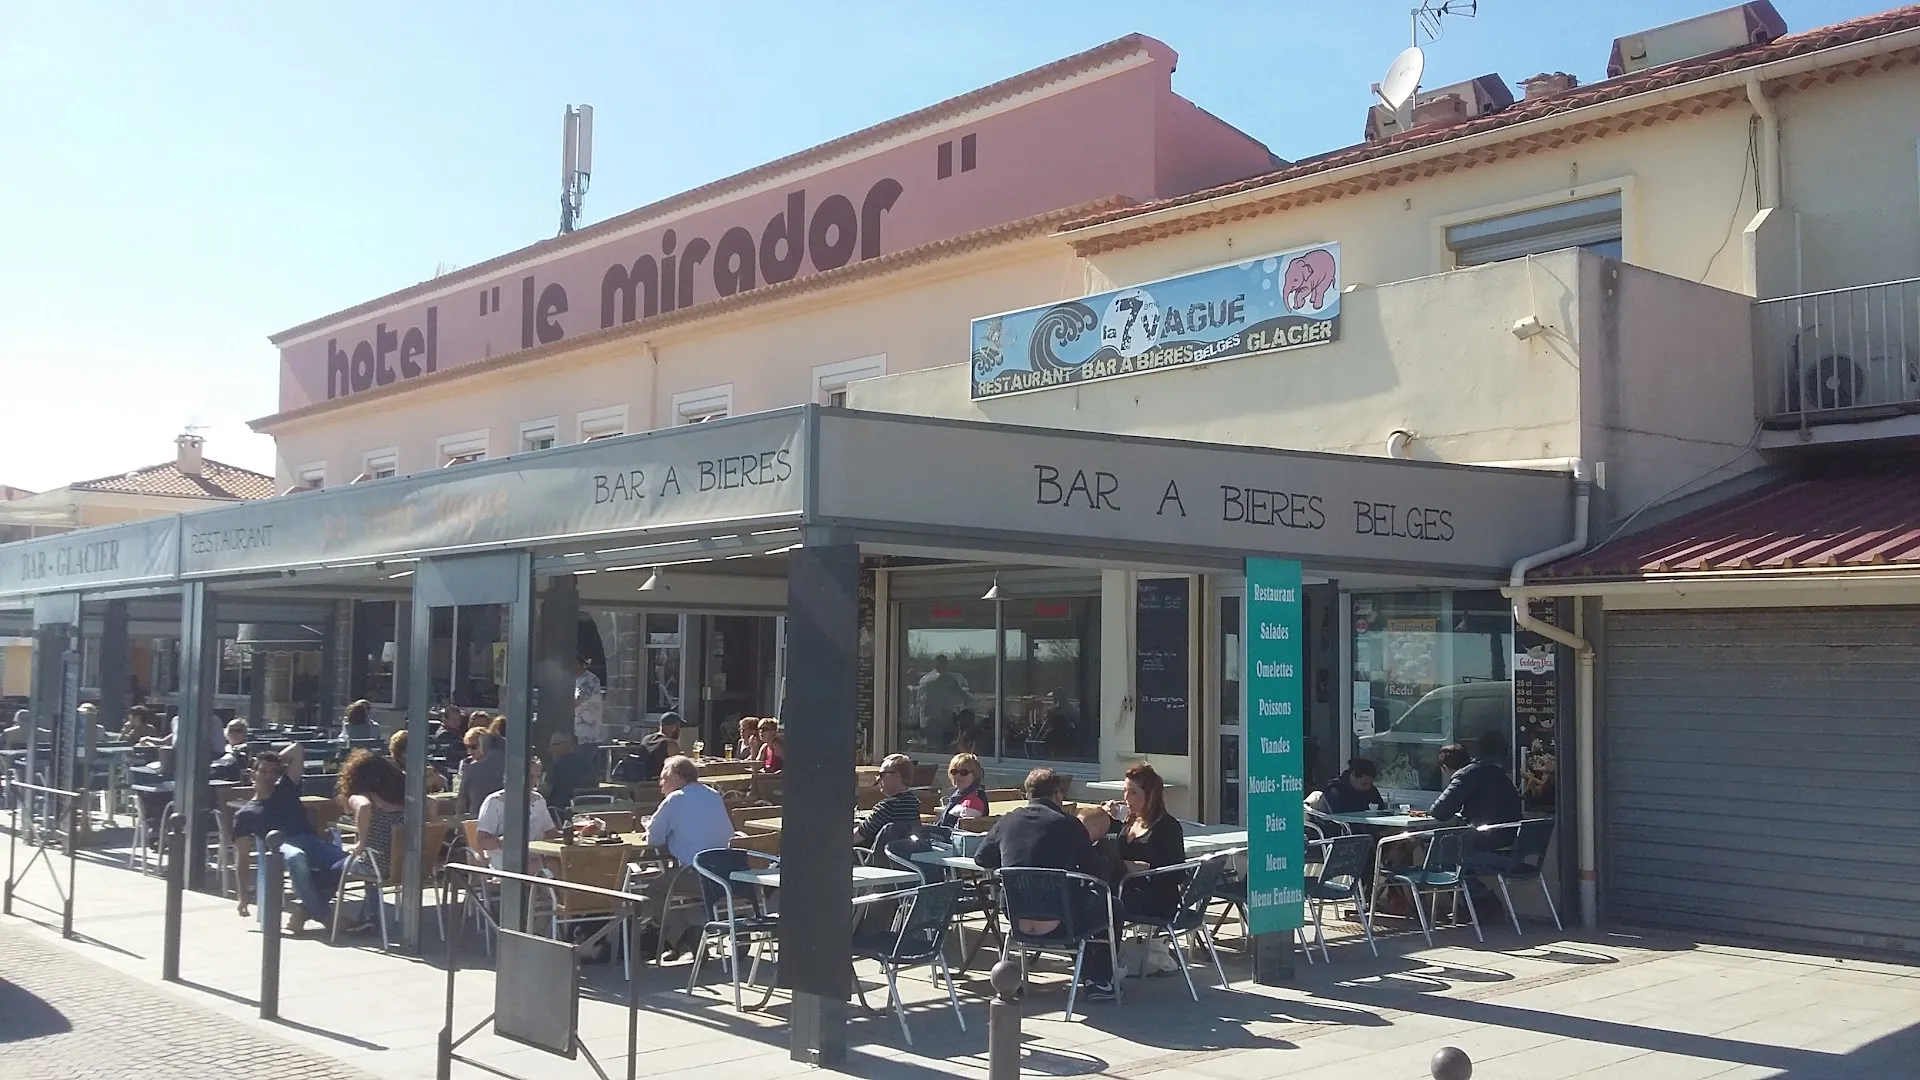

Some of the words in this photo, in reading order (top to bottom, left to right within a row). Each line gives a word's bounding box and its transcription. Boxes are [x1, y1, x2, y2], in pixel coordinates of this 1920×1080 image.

[327, 306, 438, 400] hotel
[521, 276, 569, 350] le
[600, 178, 904, 330] mirador
[1102, 325, 1117, 341] la
[1141, 293, 1246, 342] VAGUE
[978, 366, 1074, 396] RESTAURANT
[1081, 358, 1117, 380] BAR
[1193, 334, 1241, 362] BELGES
[1246, 320, 1332, 351] GLACIER
[594, 470, 645, 504] BAR
[660, 465, 681, 497] A
[697, 449, 792, 492] BIERES
[1033, 465, 1121, 511] BAR
[1156, 480, 1186, 516] A
[1220, 485, 1325, 531] BIERES
[1353, 500, 1455, 541] BELGES
[191, 525, 274, 555] RESTAURANT
[1253, 583, 1295, 603] Restaurant
[1260, 621, 1290, 640] Salades
[1256, 659, 1294, 678] Omelettes
[1258, 698, 1292, 716] Poissons
[1260, 736, 1291, 754] Viandes
[1248, 775, 1276, 794] Moules
[1280, 774, 1303, 792] Frites
[1265, 812, 1287, 832] Pâtes
[1265, 853, 1287, 872] Menu
[1250, 889, 1272, 909] Menu
[1273, 887, 1303, 906] Enfants
